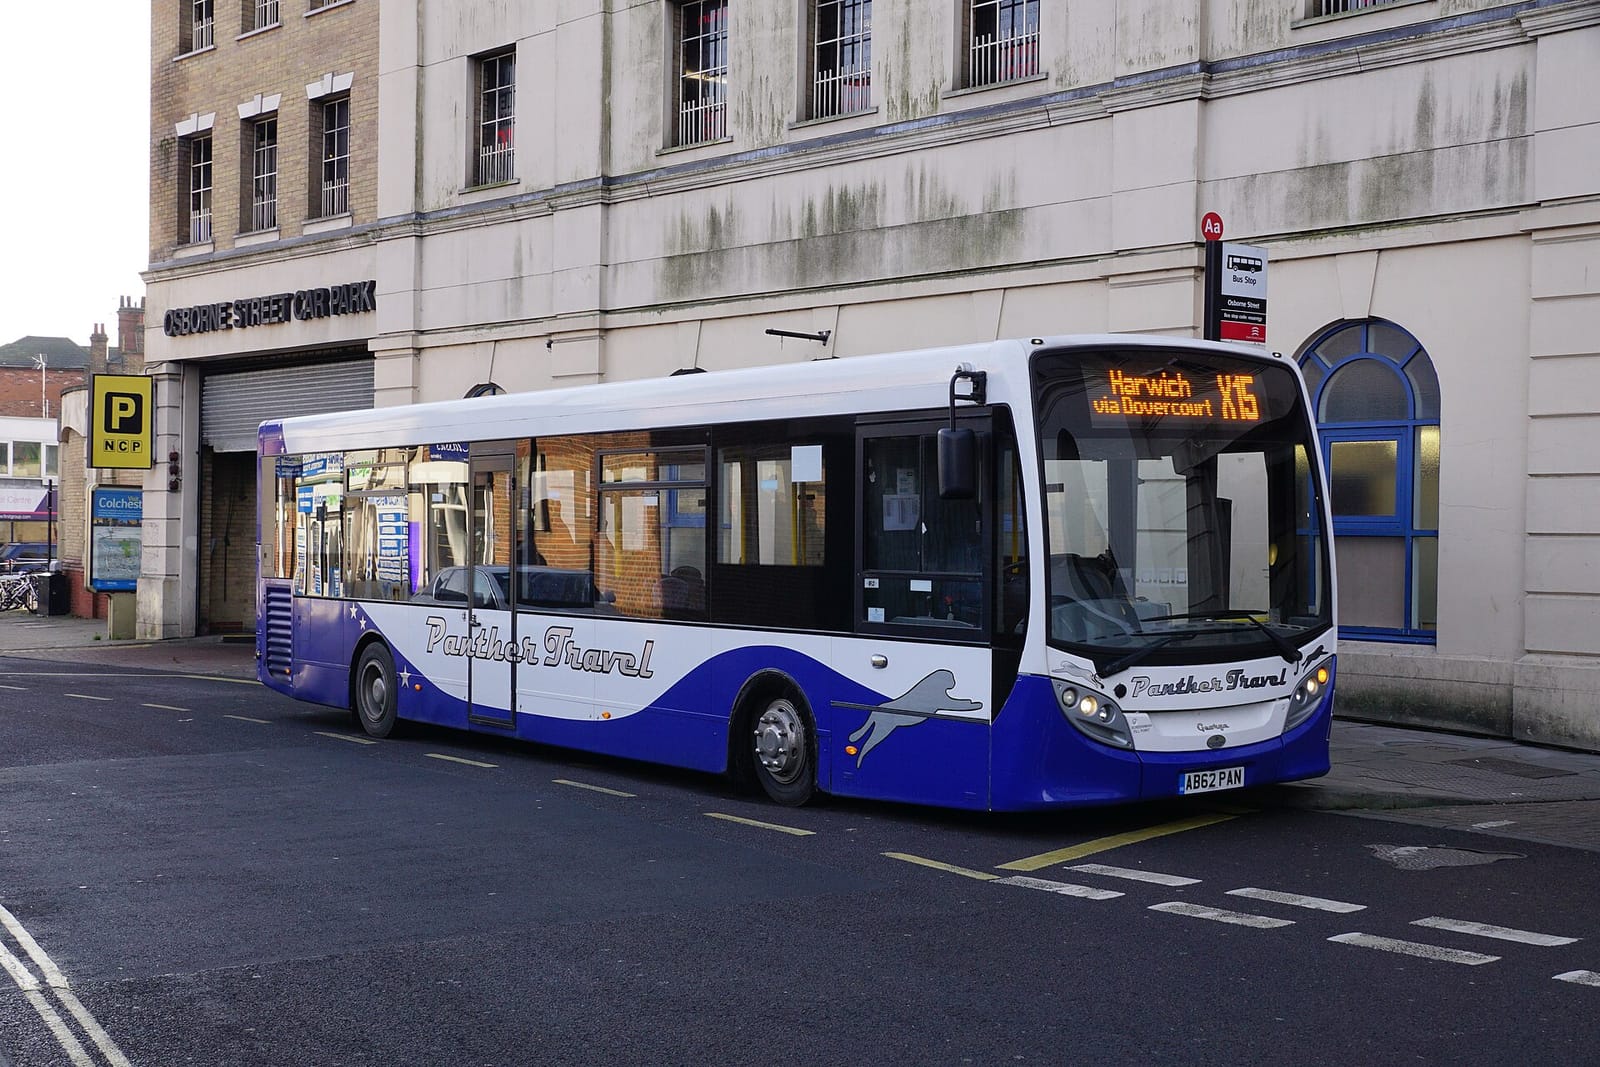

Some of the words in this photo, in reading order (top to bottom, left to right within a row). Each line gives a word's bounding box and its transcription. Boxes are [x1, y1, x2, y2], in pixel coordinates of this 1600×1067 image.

[1205, 218, 1220, 233] Aa
[1232, 274, 1243, 283] Bus
[1244, 276, 1257, 286] Stop
[163, 302, 233, 337] OSBORNE
[232, 292, 294, 328] STREET
[293, 288, 330, 320] CAR
[330, 280, 376, 315] PARK
[1227, 299, 1247, 307] Osborne
[1247, 301, 1260, 309] Street
[1093, 395, 1120, 414] via
[1121, 396, 1213, 417] Dovercourt
[1109, 369, 1192, 397] Harwich
[1216, 375, 1260, 419] X15
[111, 396, 136, 429] P
[425, 615, 540, 665] Panther
[543, 625, 655, 678] Travel
[1130, 675, 1223, 698] Panther
[1225, 667, 1287, 691] Travel
[1186, 772, 1216, 790] AB62
[1219, 768, 1242, 787] PAN
